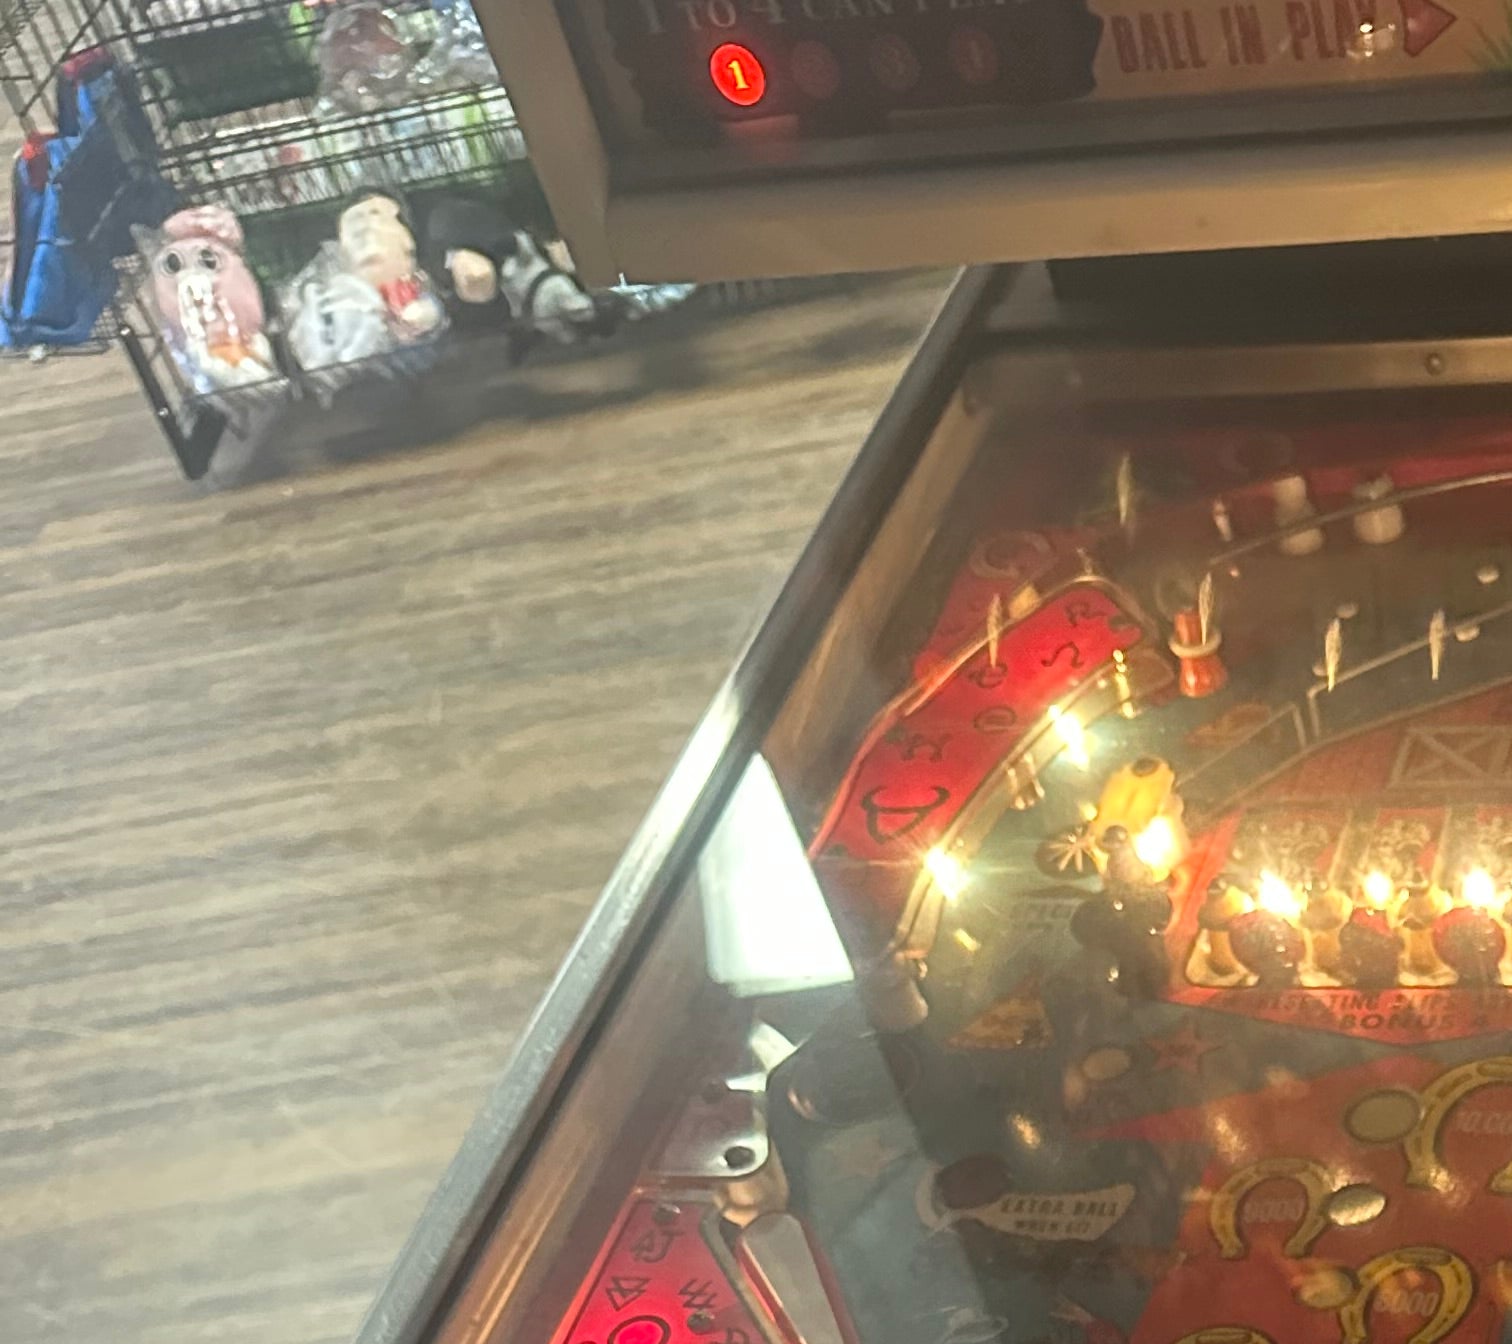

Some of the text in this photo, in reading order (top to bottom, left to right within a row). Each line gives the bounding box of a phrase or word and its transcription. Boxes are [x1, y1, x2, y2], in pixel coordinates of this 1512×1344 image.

[1110, 10, 1207, 73] BALL
[1219, 5, 1268, 66] IN
[727, 59, 750, 90] 1
